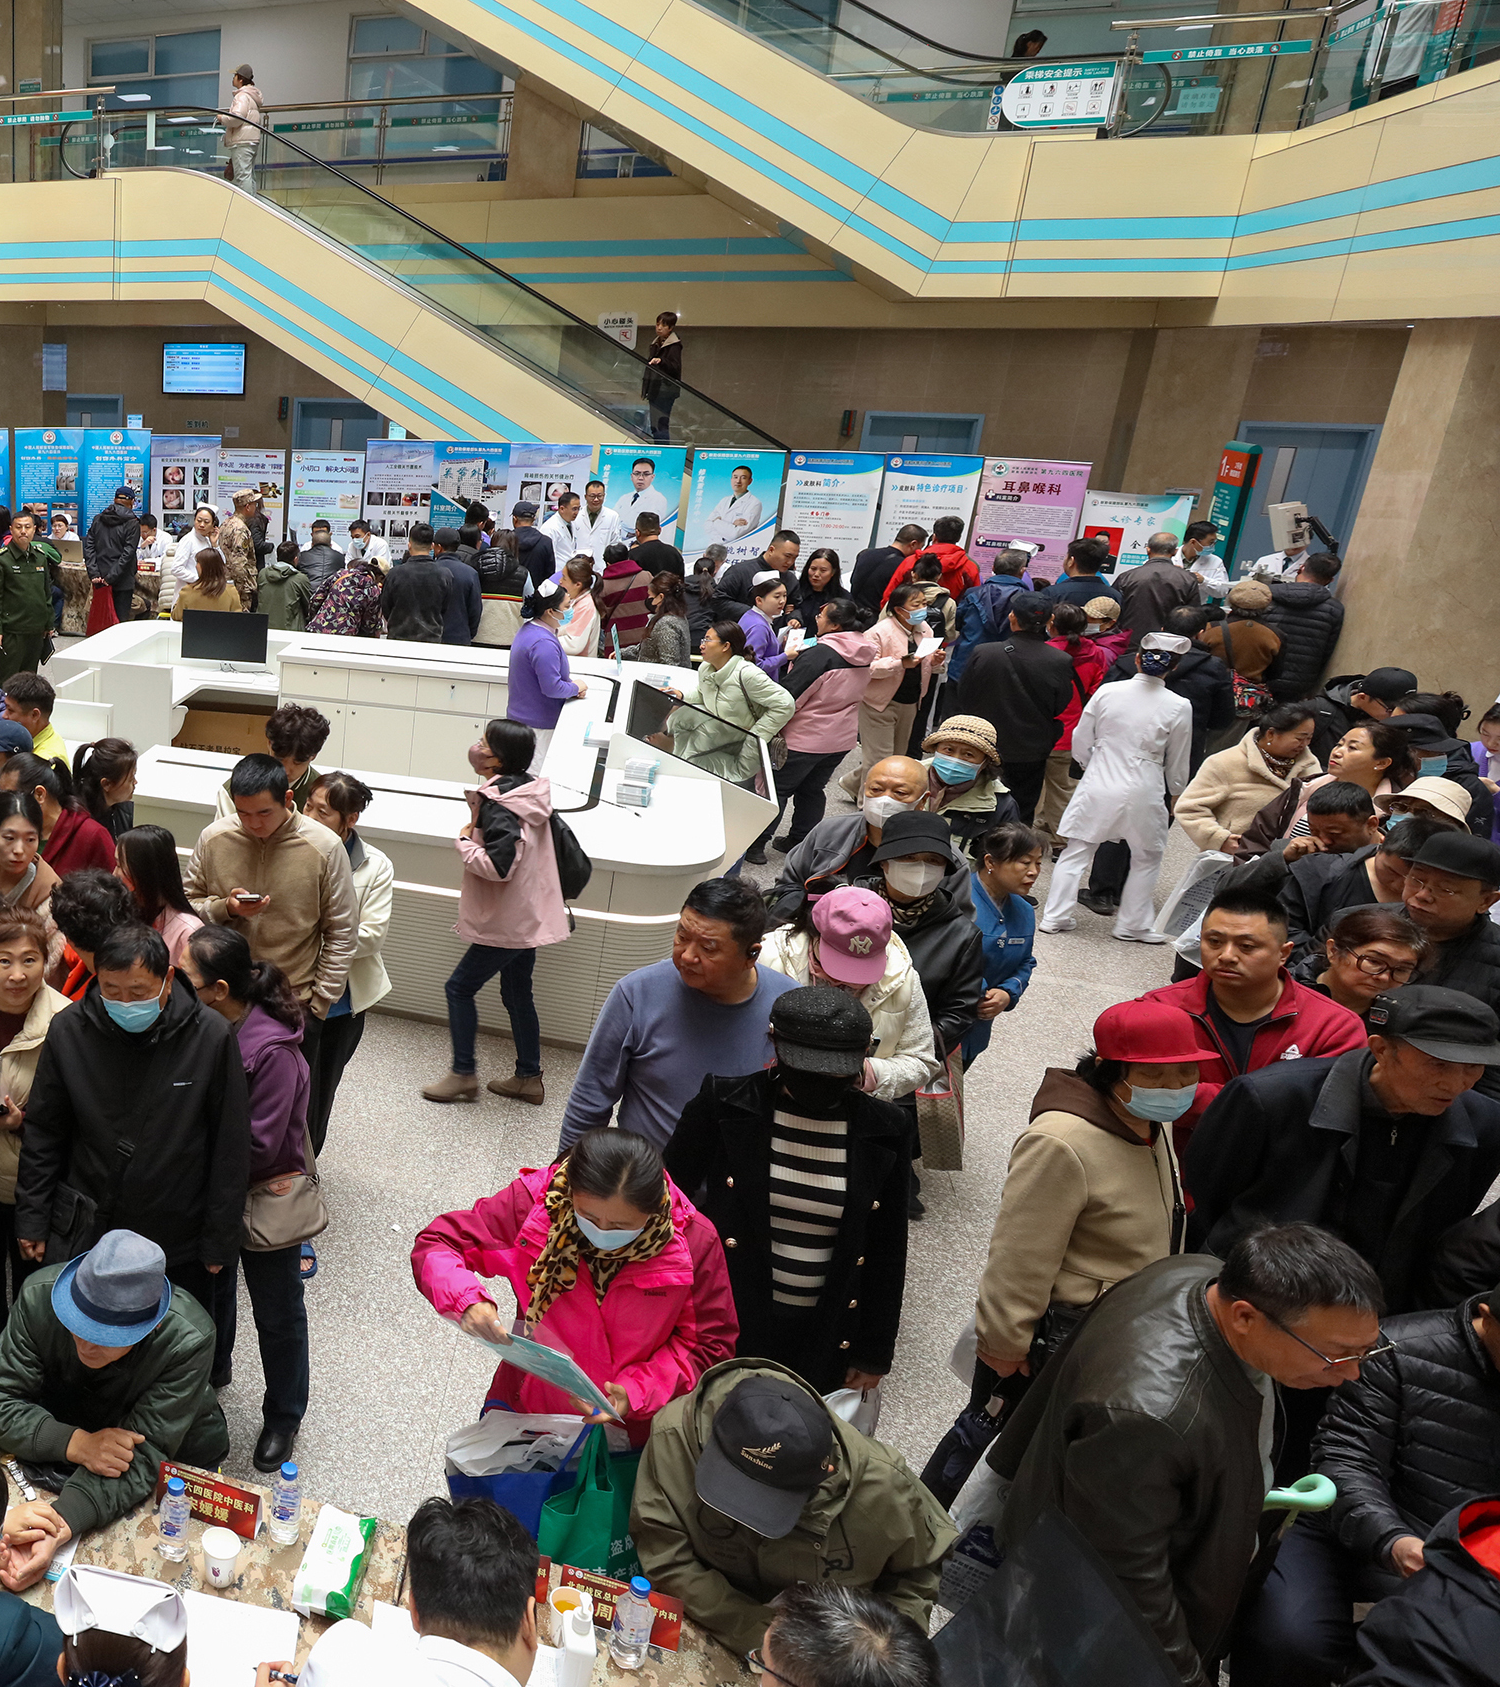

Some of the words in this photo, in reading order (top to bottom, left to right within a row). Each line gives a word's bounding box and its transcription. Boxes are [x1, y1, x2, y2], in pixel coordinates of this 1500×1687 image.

[1187, 48, 1223, 61] 禁止倚靠
[1228, 45, 1265, 57] 当心跌落
[1024, 64, 1083, 80] 乘梯安全提示
[300, 465, 320, 473] 小切口
[324, 465, 360, 474] 解决大问题
[1040, 467, 1084, 478] 第九六四医院
[823, 478, 841, 488] 简介
[916, 483, 964, 494] 特色诊疗项目
[1002, 480, 1062, 496] 耳鼻喉科
[433, 504, 458, 512] 科室简介
[1109, 515, 1156, 527] 义诊专家
[848, 935, 873, 955] NY
[740, 1449, 774, 1471] Sunshine
